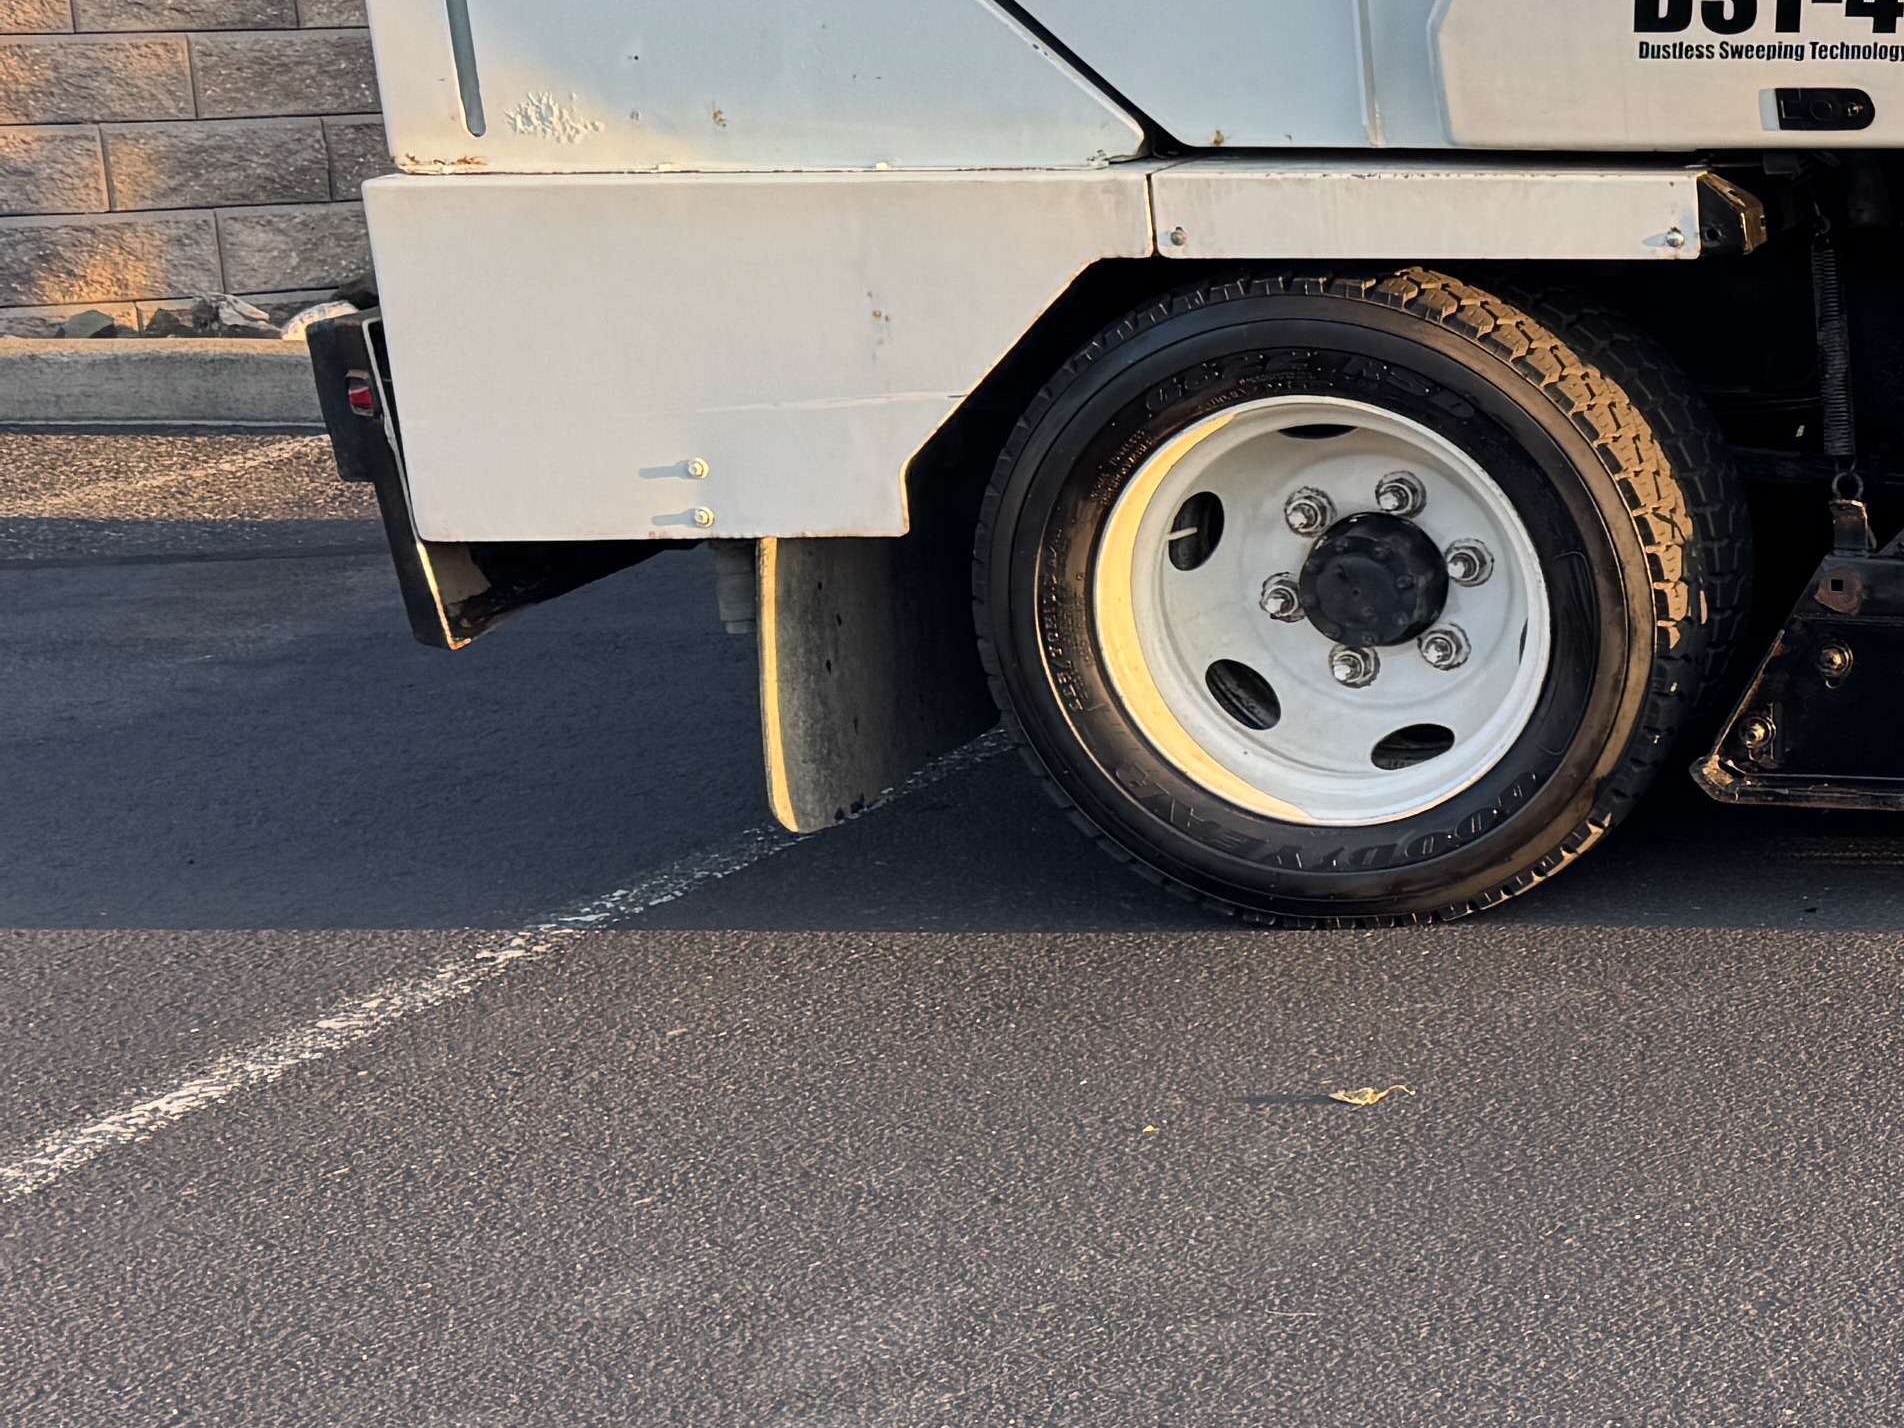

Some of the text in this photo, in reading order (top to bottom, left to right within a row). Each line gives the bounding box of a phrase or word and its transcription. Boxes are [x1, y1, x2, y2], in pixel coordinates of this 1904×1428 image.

[1638, 41, 1715, 60] Dustless
[1719, 41, 1805, 62] Sweeping
[1115, 767, 1538, 871] GOODYEAR
